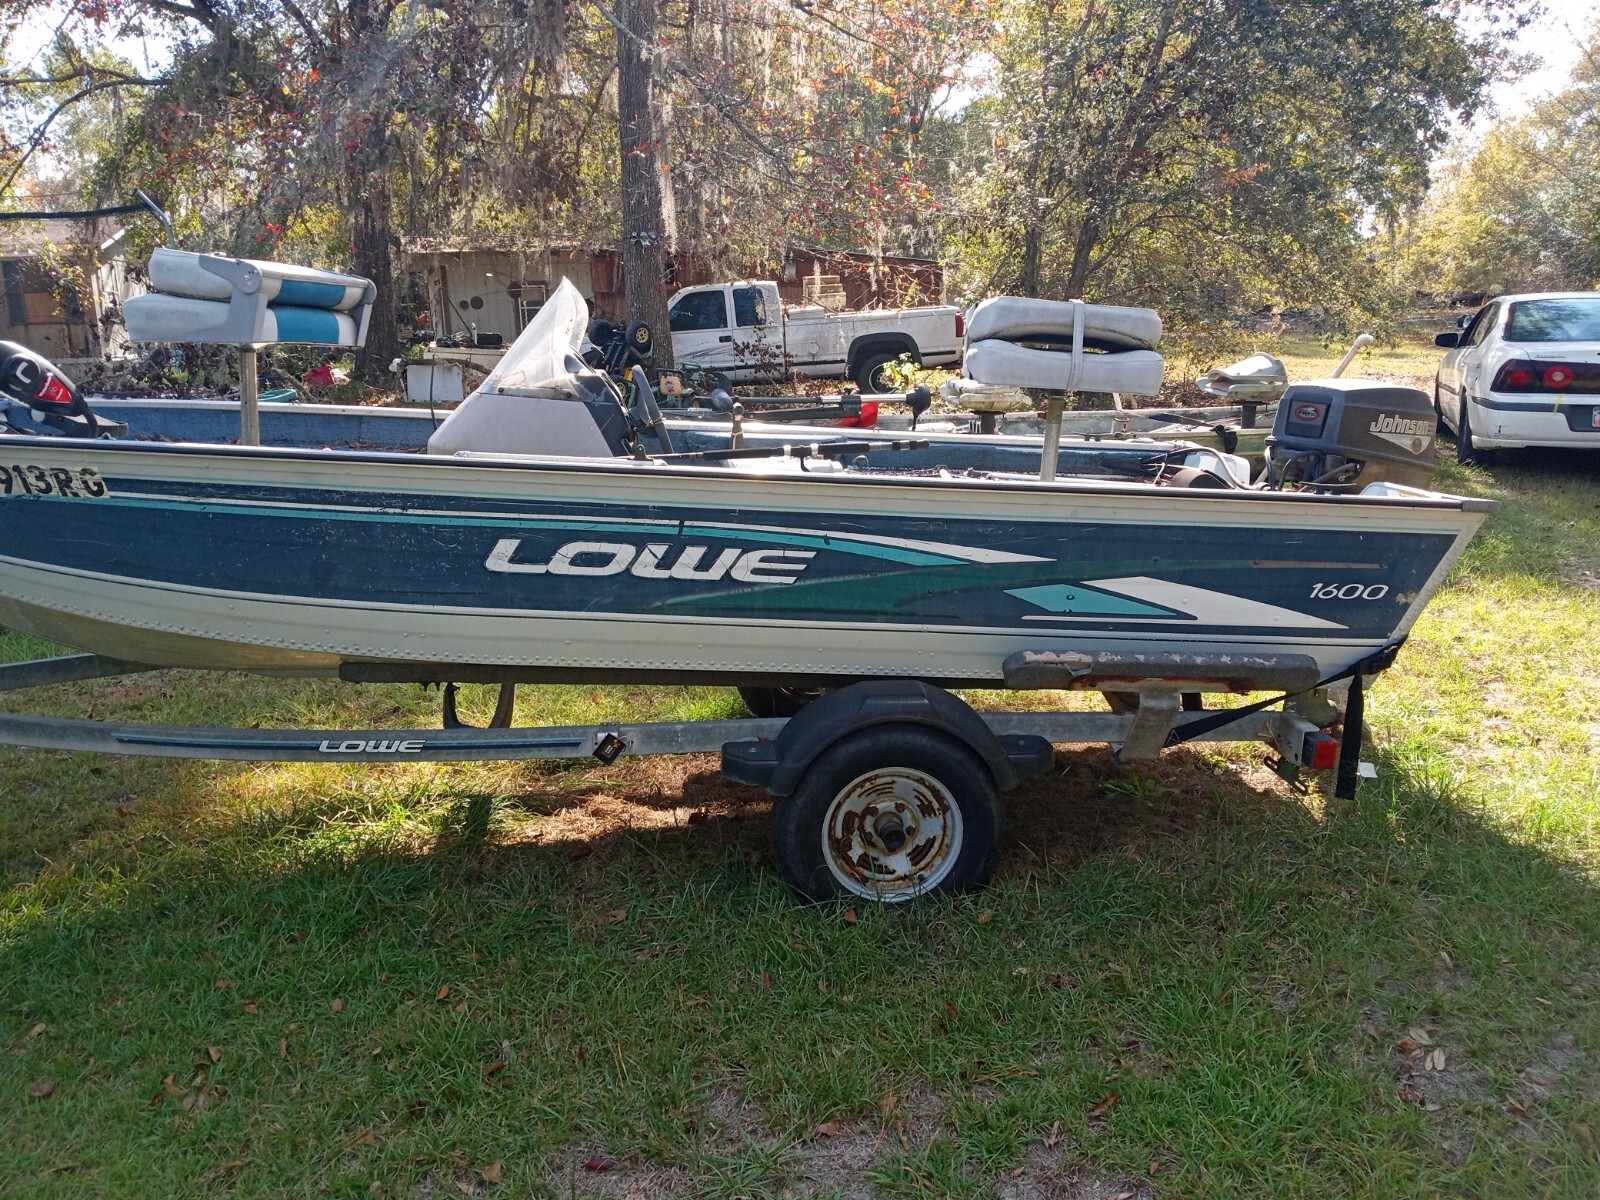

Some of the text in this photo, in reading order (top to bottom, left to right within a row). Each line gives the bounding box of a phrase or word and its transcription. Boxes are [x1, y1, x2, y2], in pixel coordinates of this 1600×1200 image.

[1369, 413, 1429, 435] Johnson
[484, 538, 817, 584] LOWE
[1309, 583, 1390, 600] 1600
[318, 740, 427, 753] LOWE
